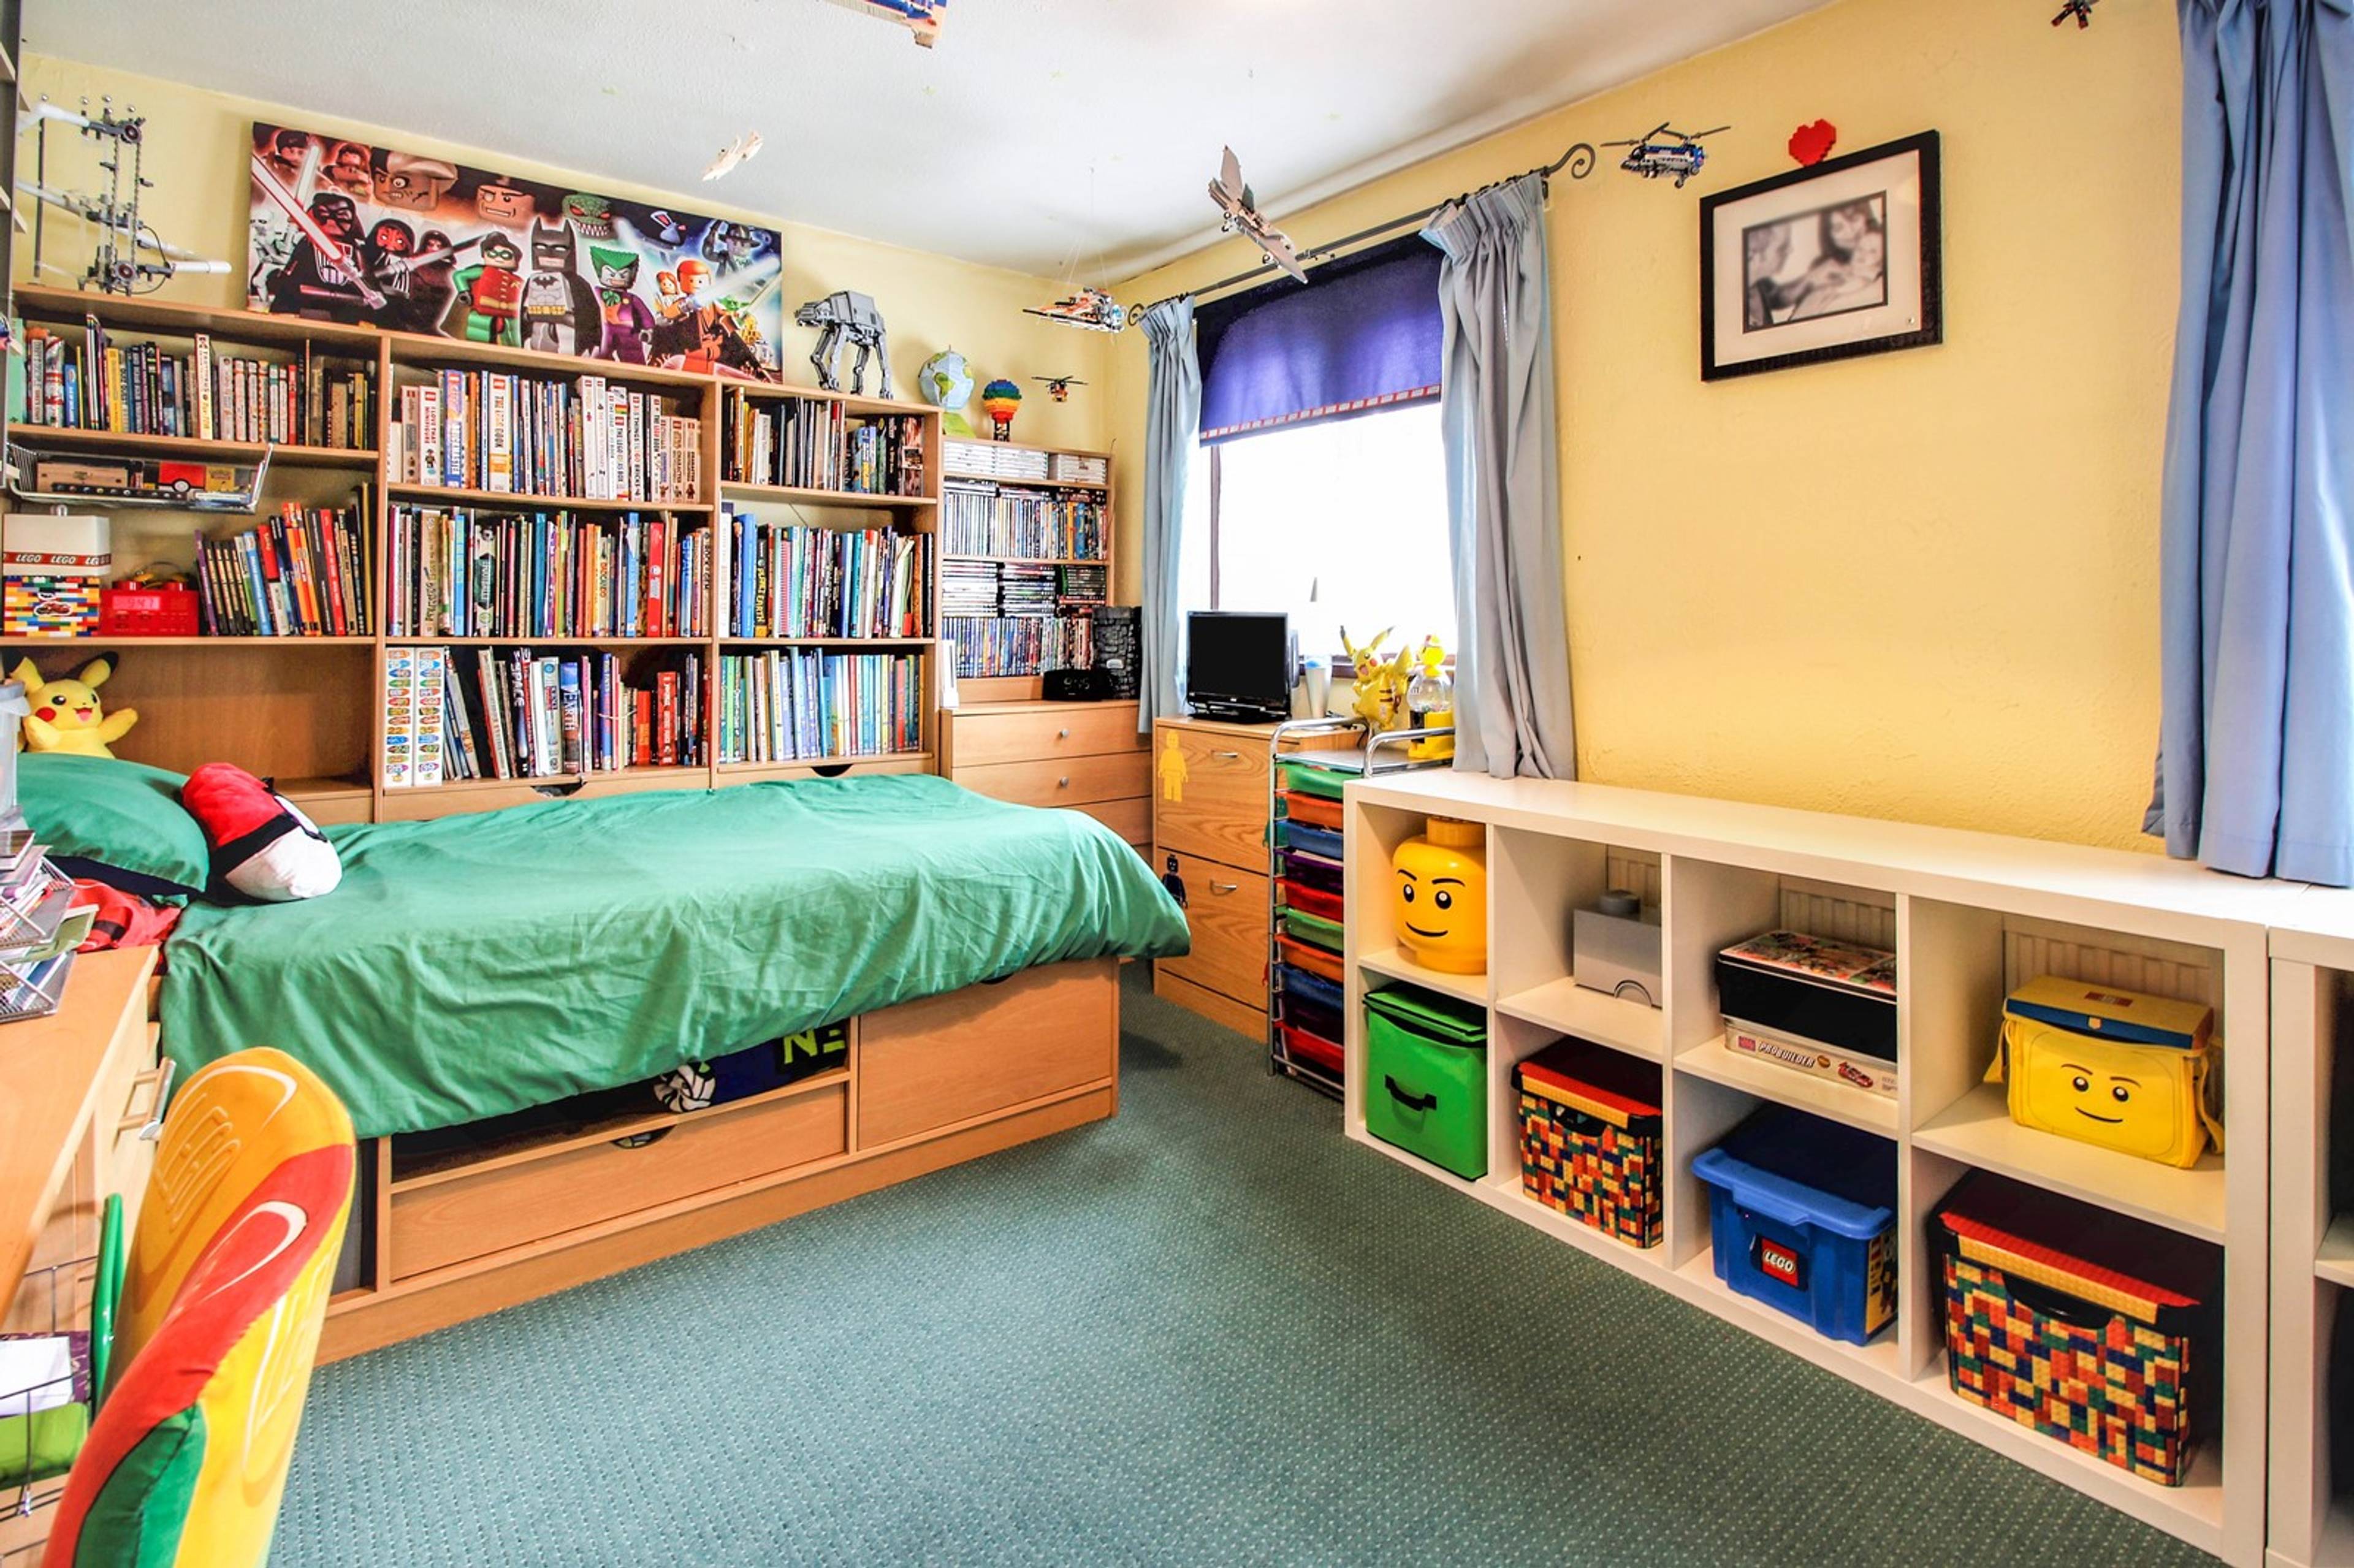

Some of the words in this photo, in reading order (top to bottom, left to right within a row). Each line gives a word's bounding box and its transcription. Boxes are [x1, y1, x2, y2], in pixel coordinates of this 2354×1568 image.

[16, 554, 42, 563] LEGO
[51, 555, 76, 564] LEGO
[511, 662, 525, 707] SPACE
[563, 693, 578, 731] EARTH
[1759, 1042, 1816, 1068] PROBUILDER
[1765, 1250, 1794, 1273] LEGO
